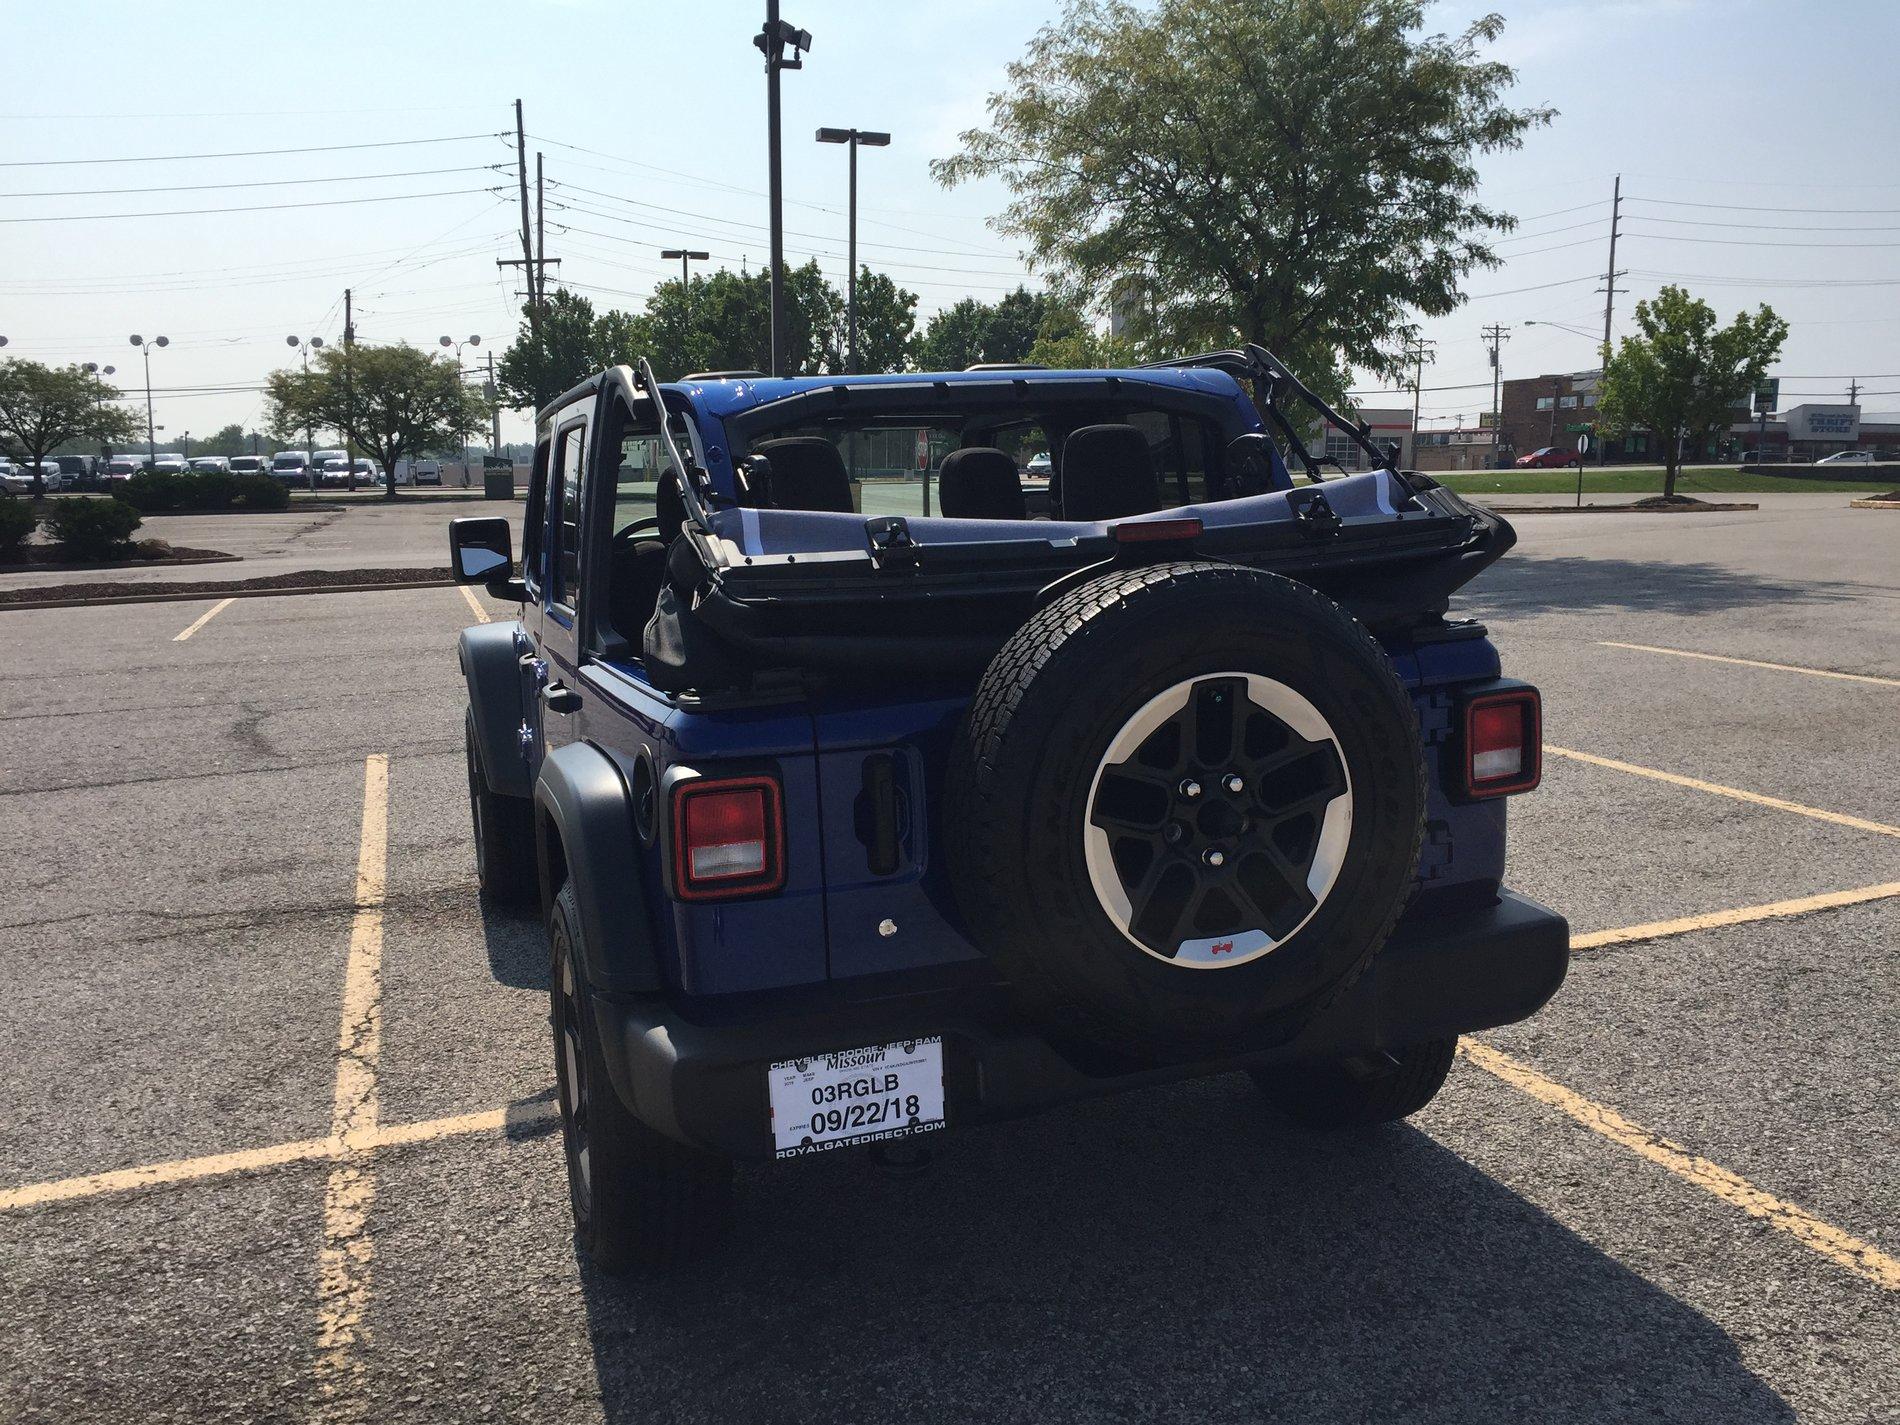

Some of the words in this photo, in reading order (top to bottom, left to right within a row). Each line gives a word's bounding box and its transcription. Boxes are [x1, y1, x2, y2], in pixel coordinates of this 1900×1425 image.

[826, 1050, 886, 1071] Missouri
[812, 1073, 899, 1105] 03RGLB
[811, 1094, 920, 1135] 09/22/18
[776, 1121, 946, 1160] ROYALGATEDIRECT.COM
